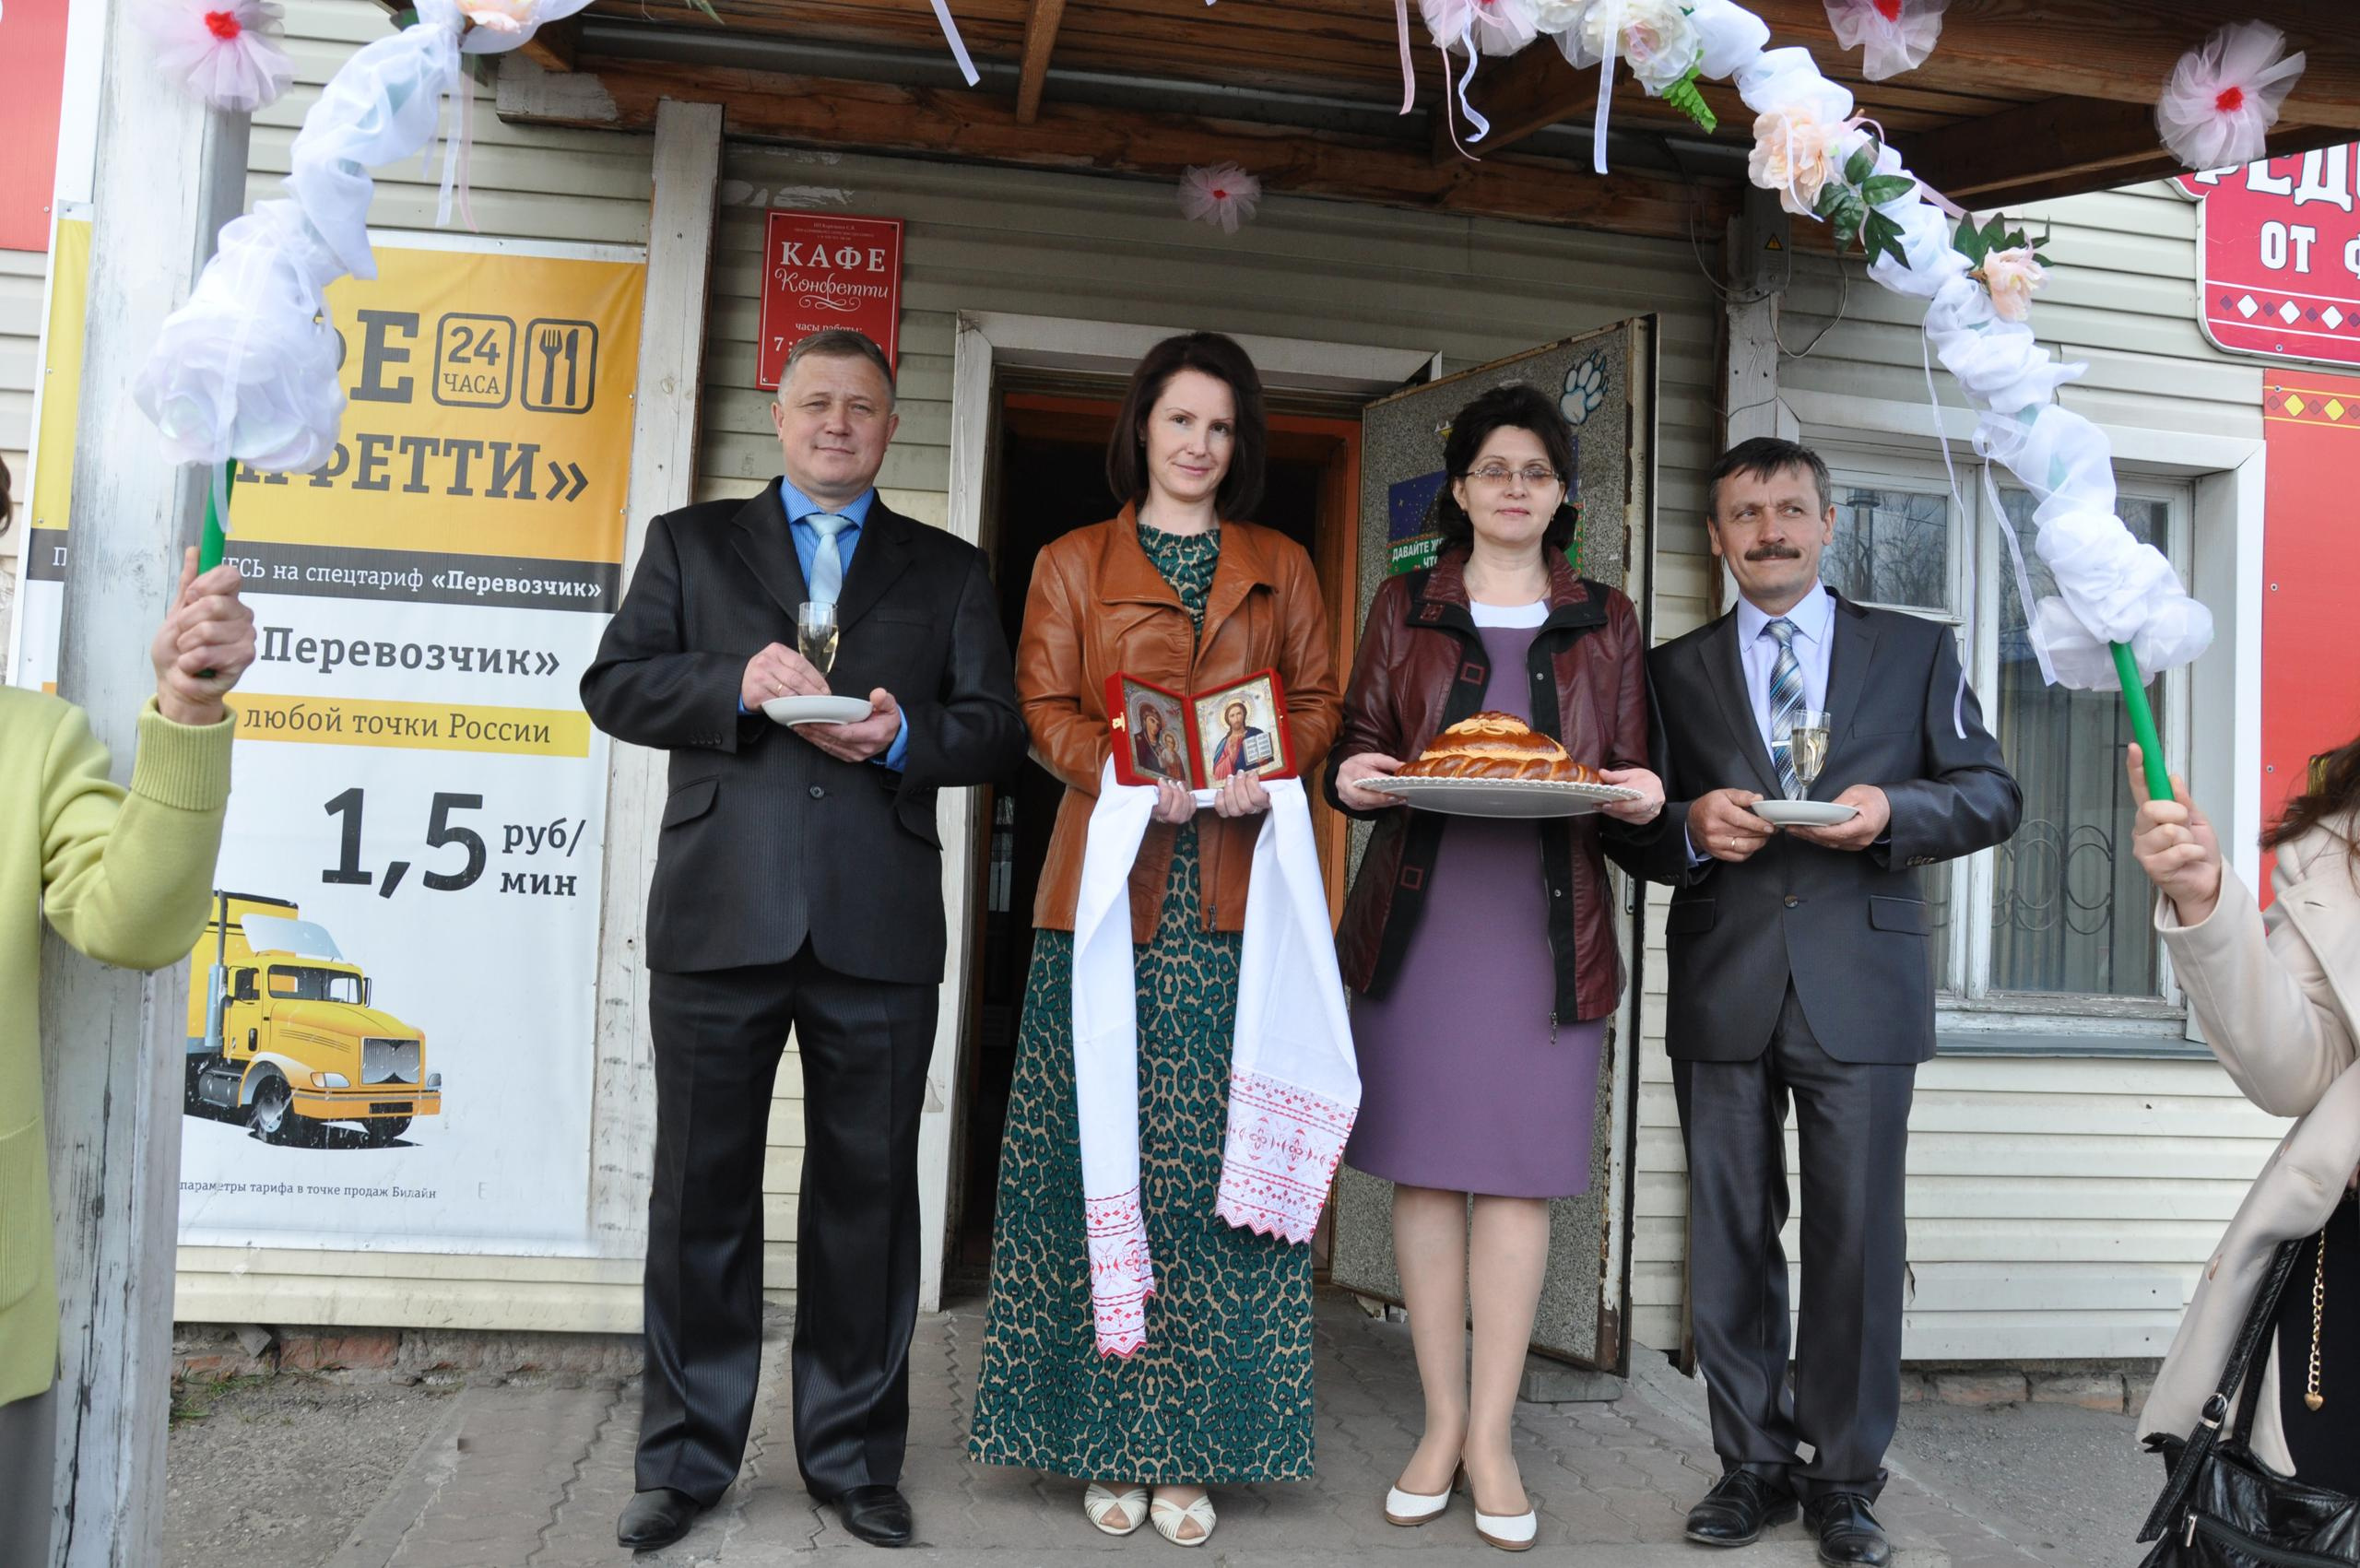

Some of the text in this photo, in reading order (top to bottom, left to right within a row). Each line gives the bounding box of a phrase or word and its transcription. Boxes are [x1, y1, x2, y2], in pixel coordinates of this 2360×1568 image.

[780, 242, 886, 272] КАФЕ
[2260, 220, 2317, 274] ОТ
[774, 267, 889, 302] Конфетти
[795, 323, 820, 332] часы
[448, 325, 501, 367] 24
[442, 372, 501, 395] ЧАСА
[1391, 540, 1430, 562] ДАВАЙТЕ
[272, 564, 300, 581] на
[306, 567, 423, 592] спецтариф
[431, 570, 602, 598] «Перевозчик»
[260, 626, 560, 677] Перевозчик»
[243, 703, 551, 744] любой точки России
[322, 787, 586, 900] 1,5 руб/
[500, 872, 577, 897] мин
[180, 1181, 436, 1199] параметры тарифа в точке продаж Билайн
